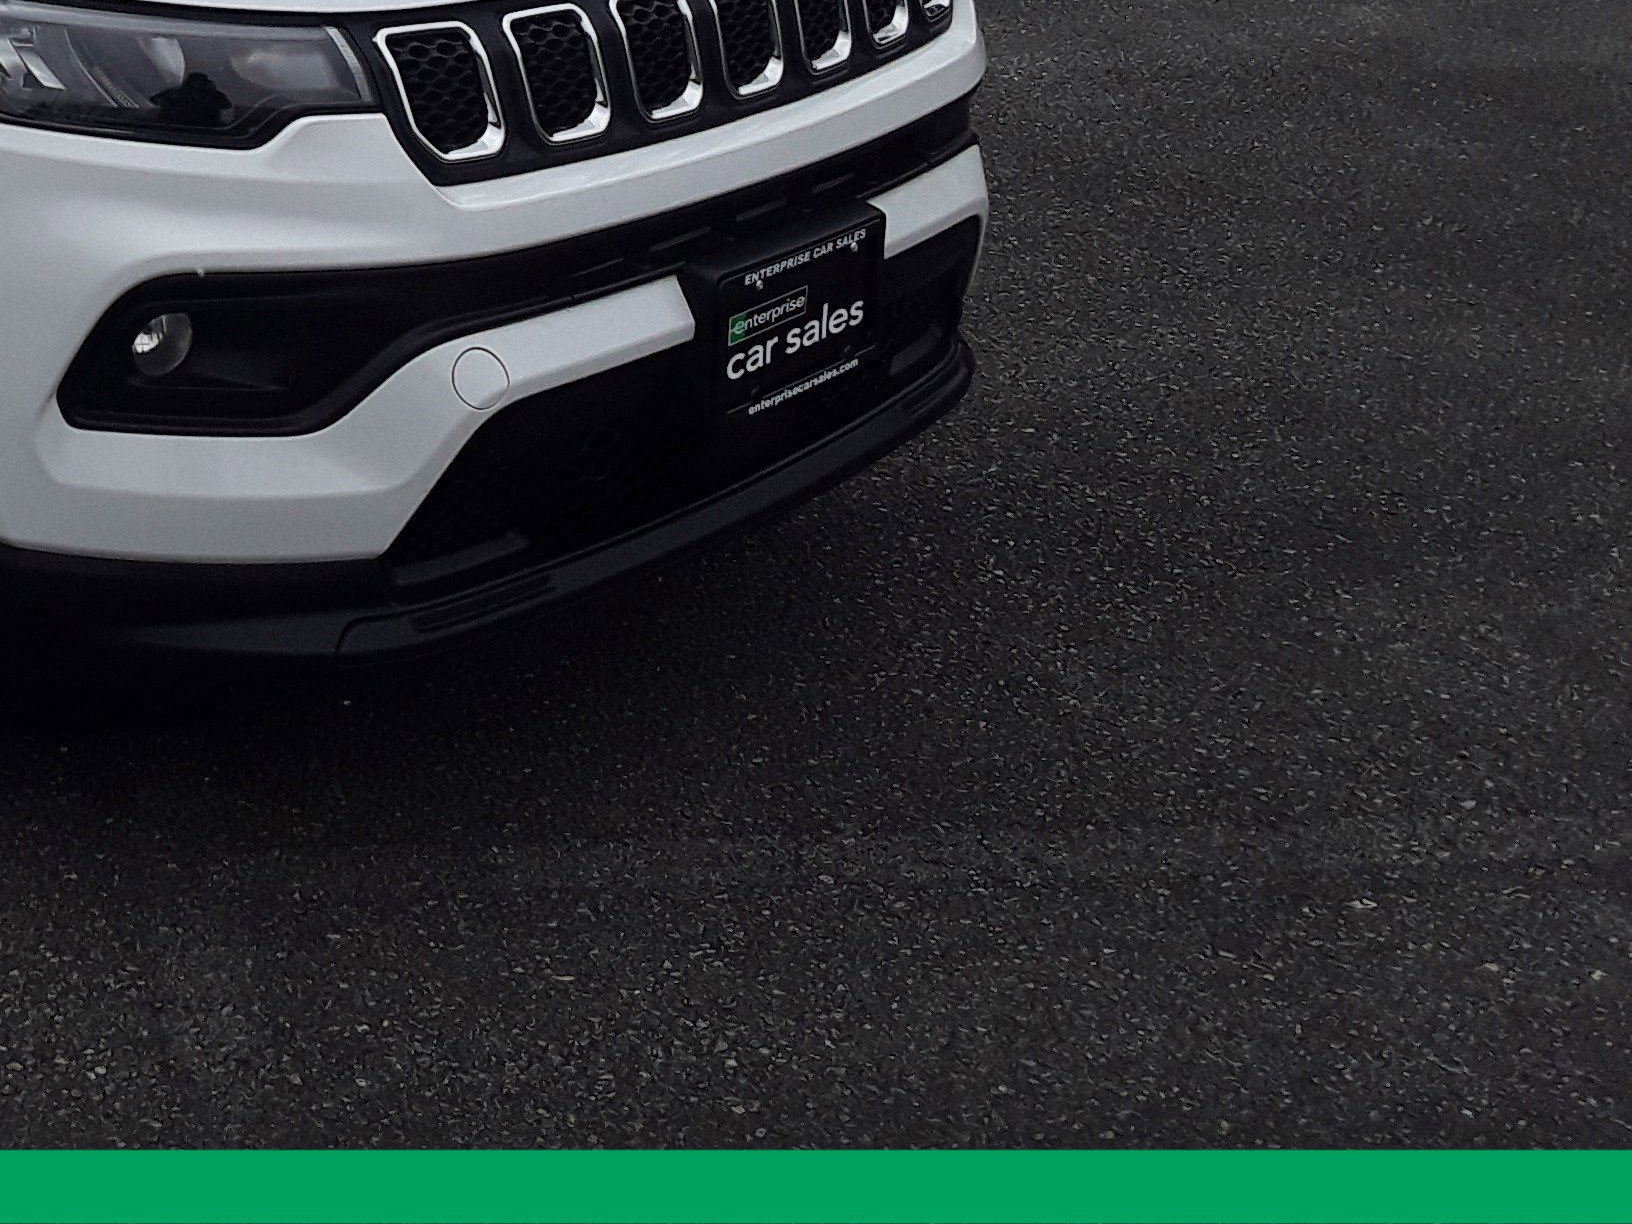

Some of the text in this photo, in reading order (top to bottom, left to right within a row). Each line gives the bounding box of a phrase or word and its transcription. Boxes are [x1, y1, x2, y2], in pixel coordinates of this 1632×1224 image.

[744, 228, 867, 286] ENTERPRISE CAR SALES
[726, 300, 865, 380] car sales
[731, 295, 806, 335] enterprise
[748, 358, 859, 416] enterprisecarsales.com
